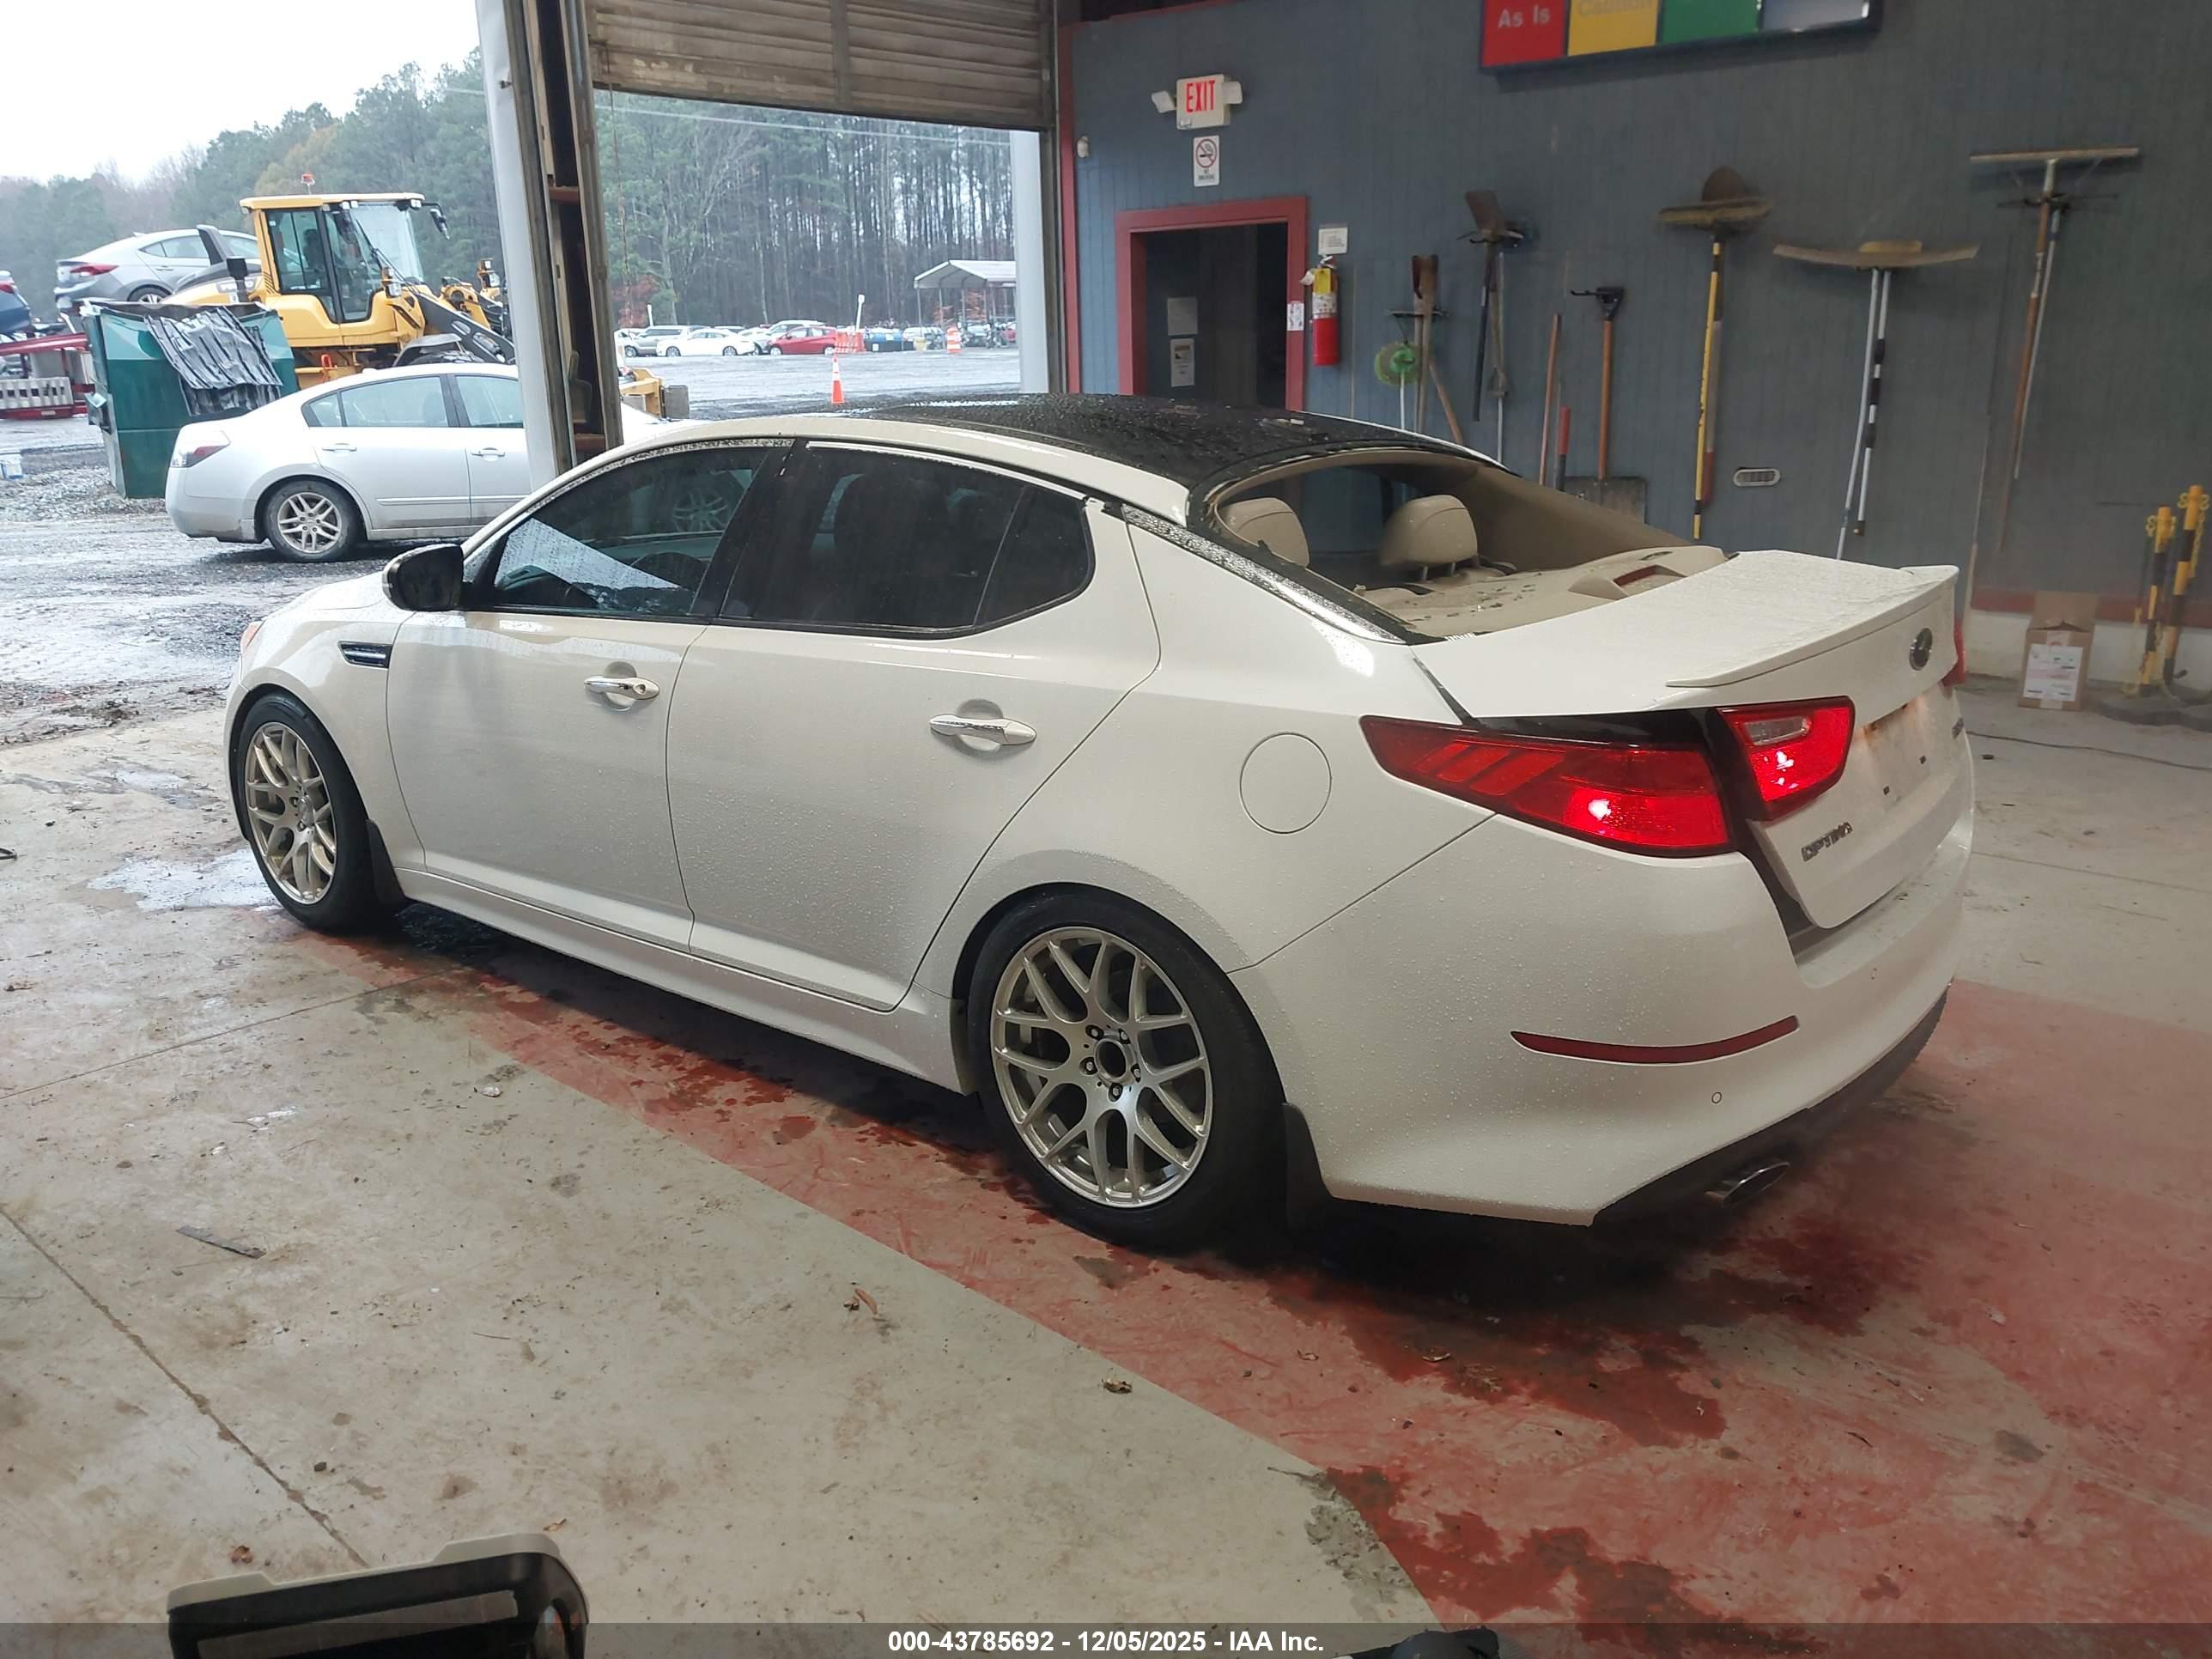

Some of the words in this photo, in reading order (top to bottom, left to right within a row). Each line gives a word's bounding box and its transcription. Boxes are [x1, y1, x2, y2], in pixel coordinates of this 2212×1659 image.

[1498, 9, 1524, 28] As
[1533, 4, 1551, 25] Is
[1186, 80, 1215, 112] EXIT
[1801, 822, 1853, 862] OPTIMA
